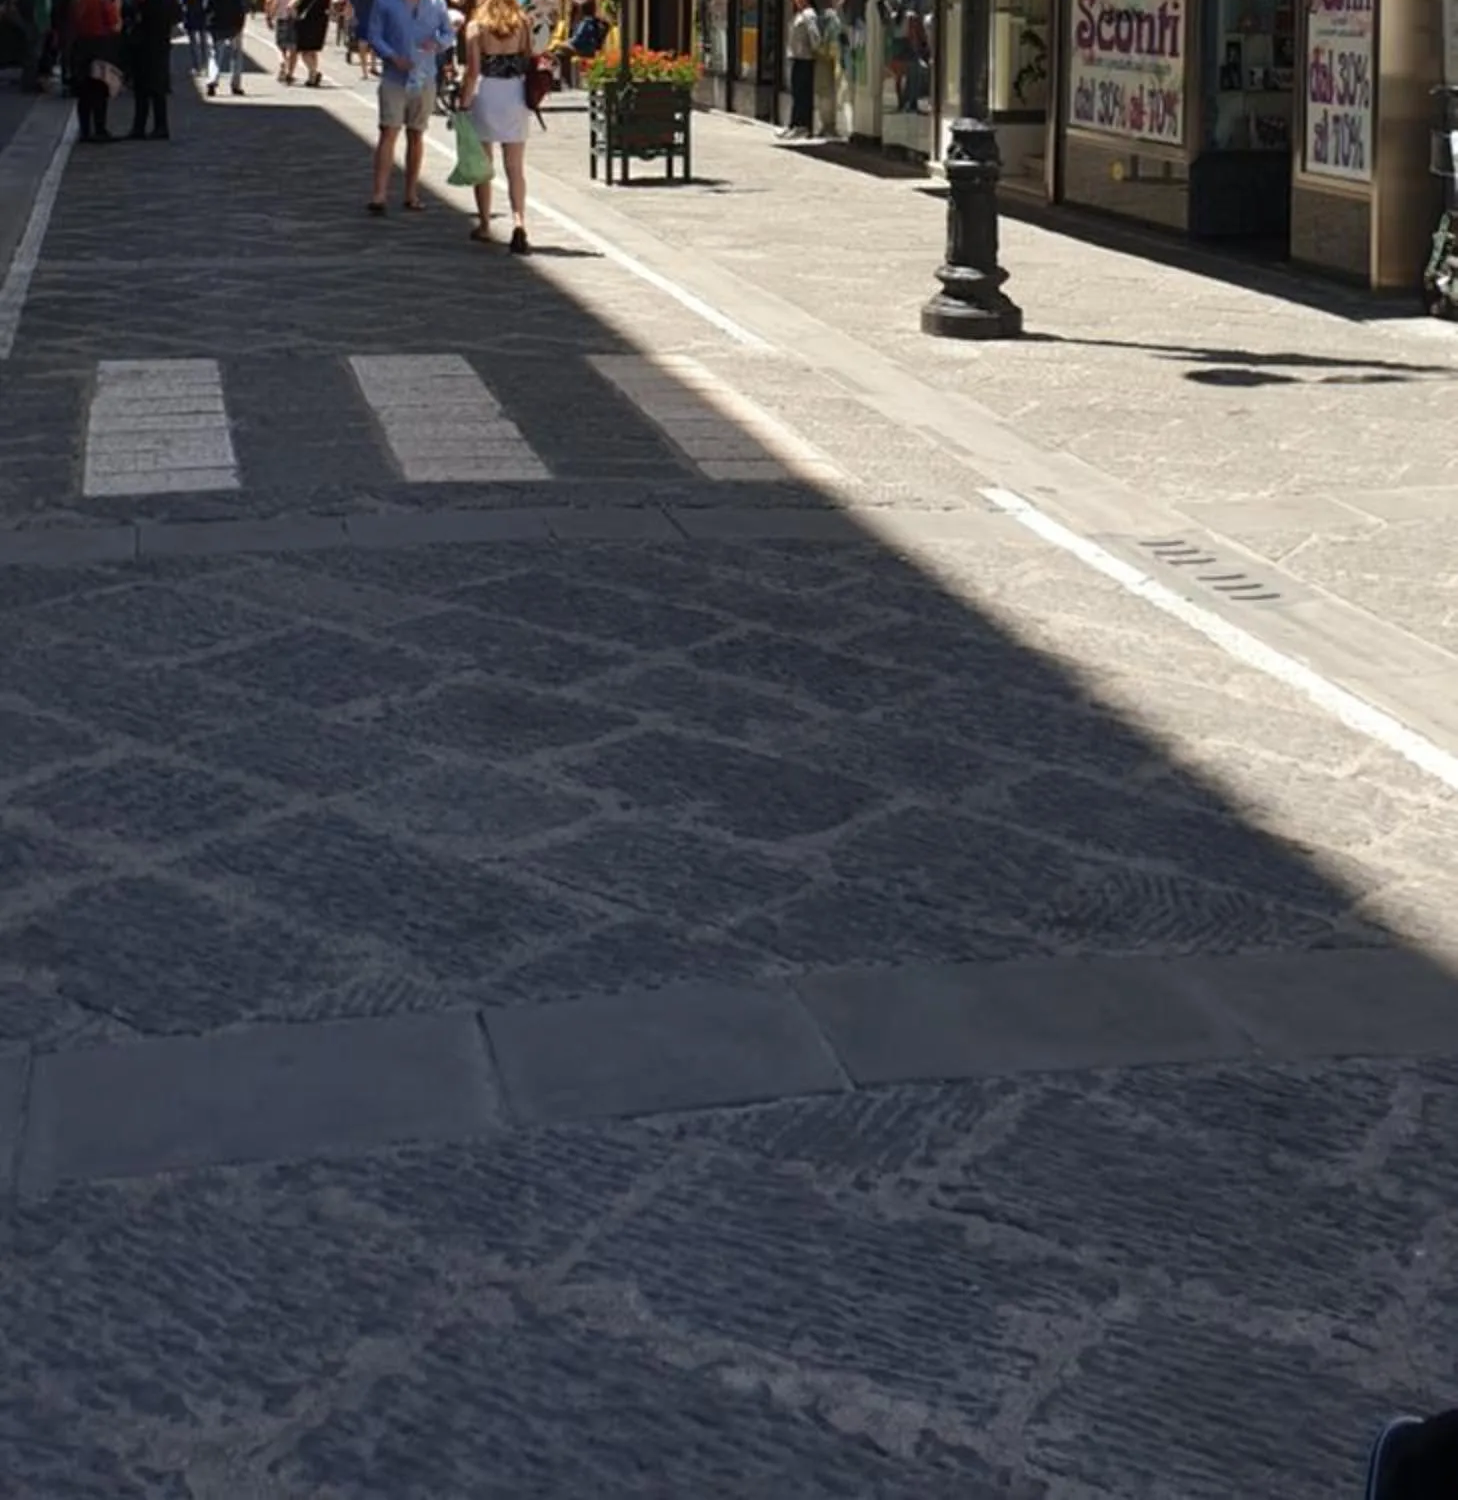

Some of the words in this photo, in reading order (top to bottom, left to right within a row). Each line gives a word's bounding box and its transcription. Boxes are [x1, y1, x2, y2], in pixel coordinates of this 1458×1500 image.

[1074, 76, 1096, 122] dal
[1310, 47, 1334, 105] dal
[1337, 52, 1371, 109] 30%
[1313, 108, 1329, 164] al
[1332, 112, 1365, 170] 70%
